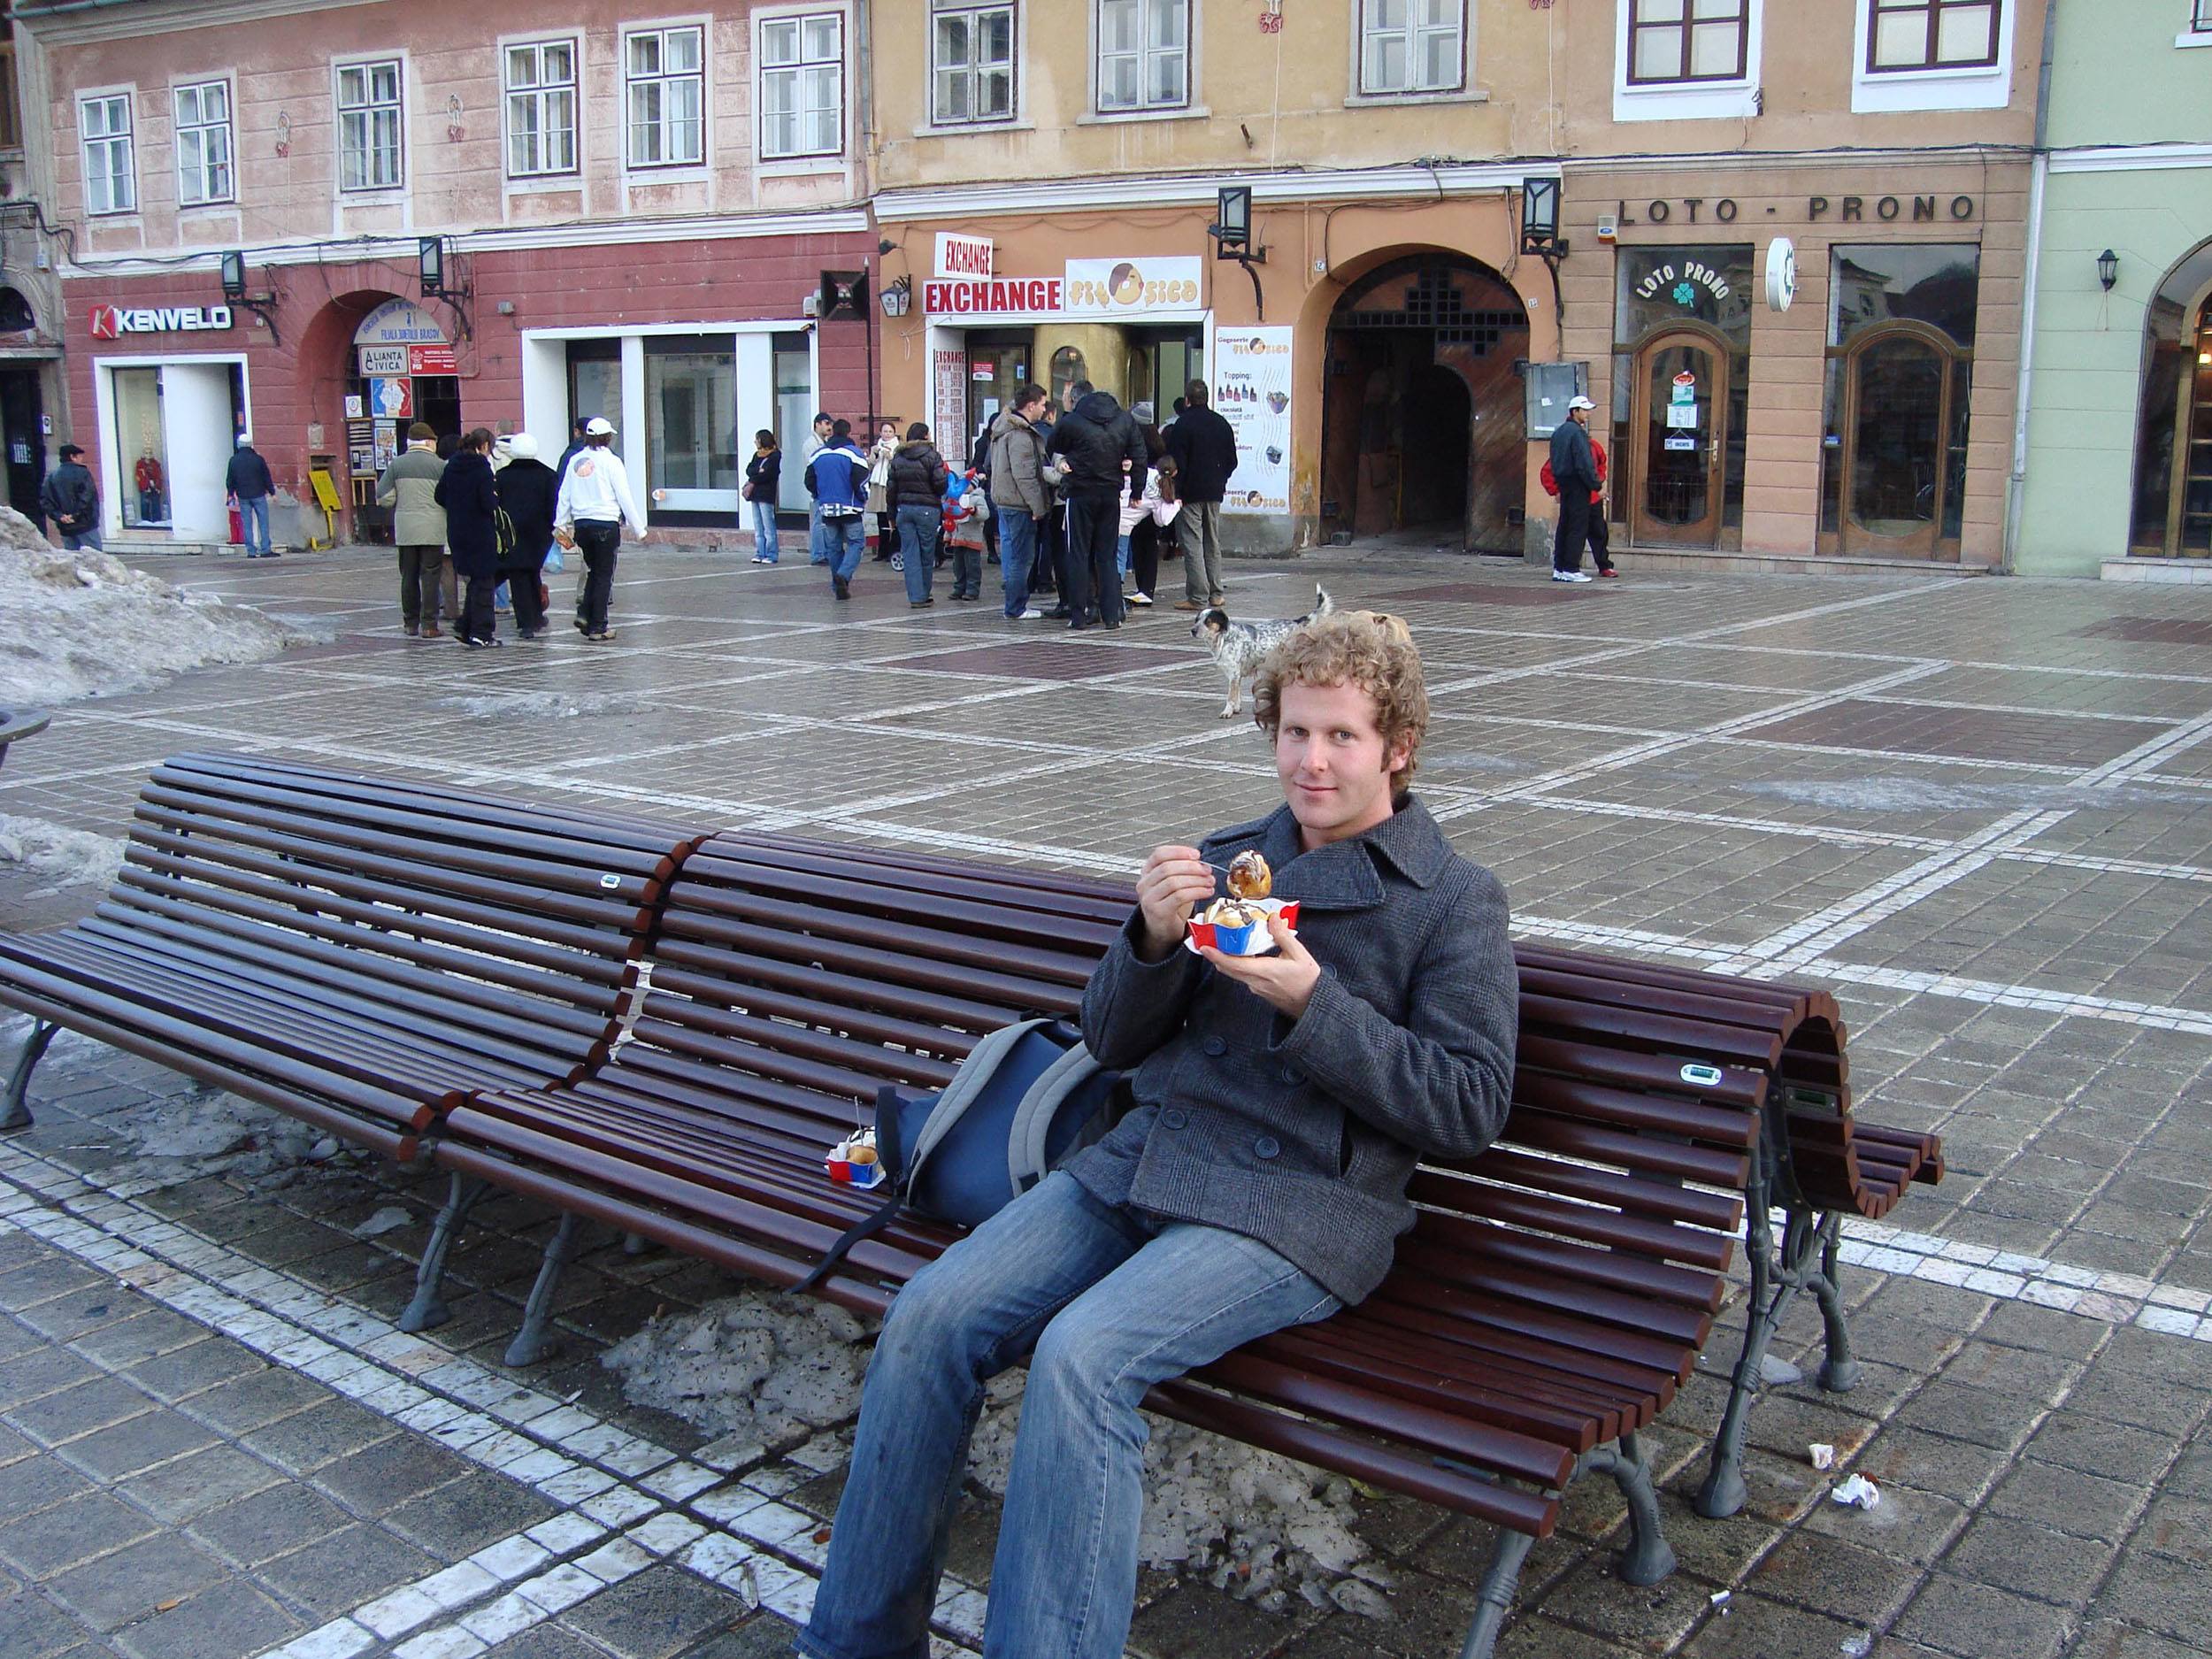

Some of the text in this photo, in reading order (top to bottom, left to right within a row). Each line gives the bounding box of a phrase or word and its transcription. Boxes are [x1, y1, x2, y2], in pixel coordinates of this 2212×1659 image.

[1617, 198, 1738, 226] LOTO
[1809, 195, 1974, 221] PRONO
[946, 240, 991, 276] EXCHANGE
[926, 280, 1061, 312] EXCHANGE
[1636, 261, 1730, 300] LOTO PRONO
[116, 306, 232, 333] KENVELO
[365, 361, 401, 371] CIVICA
